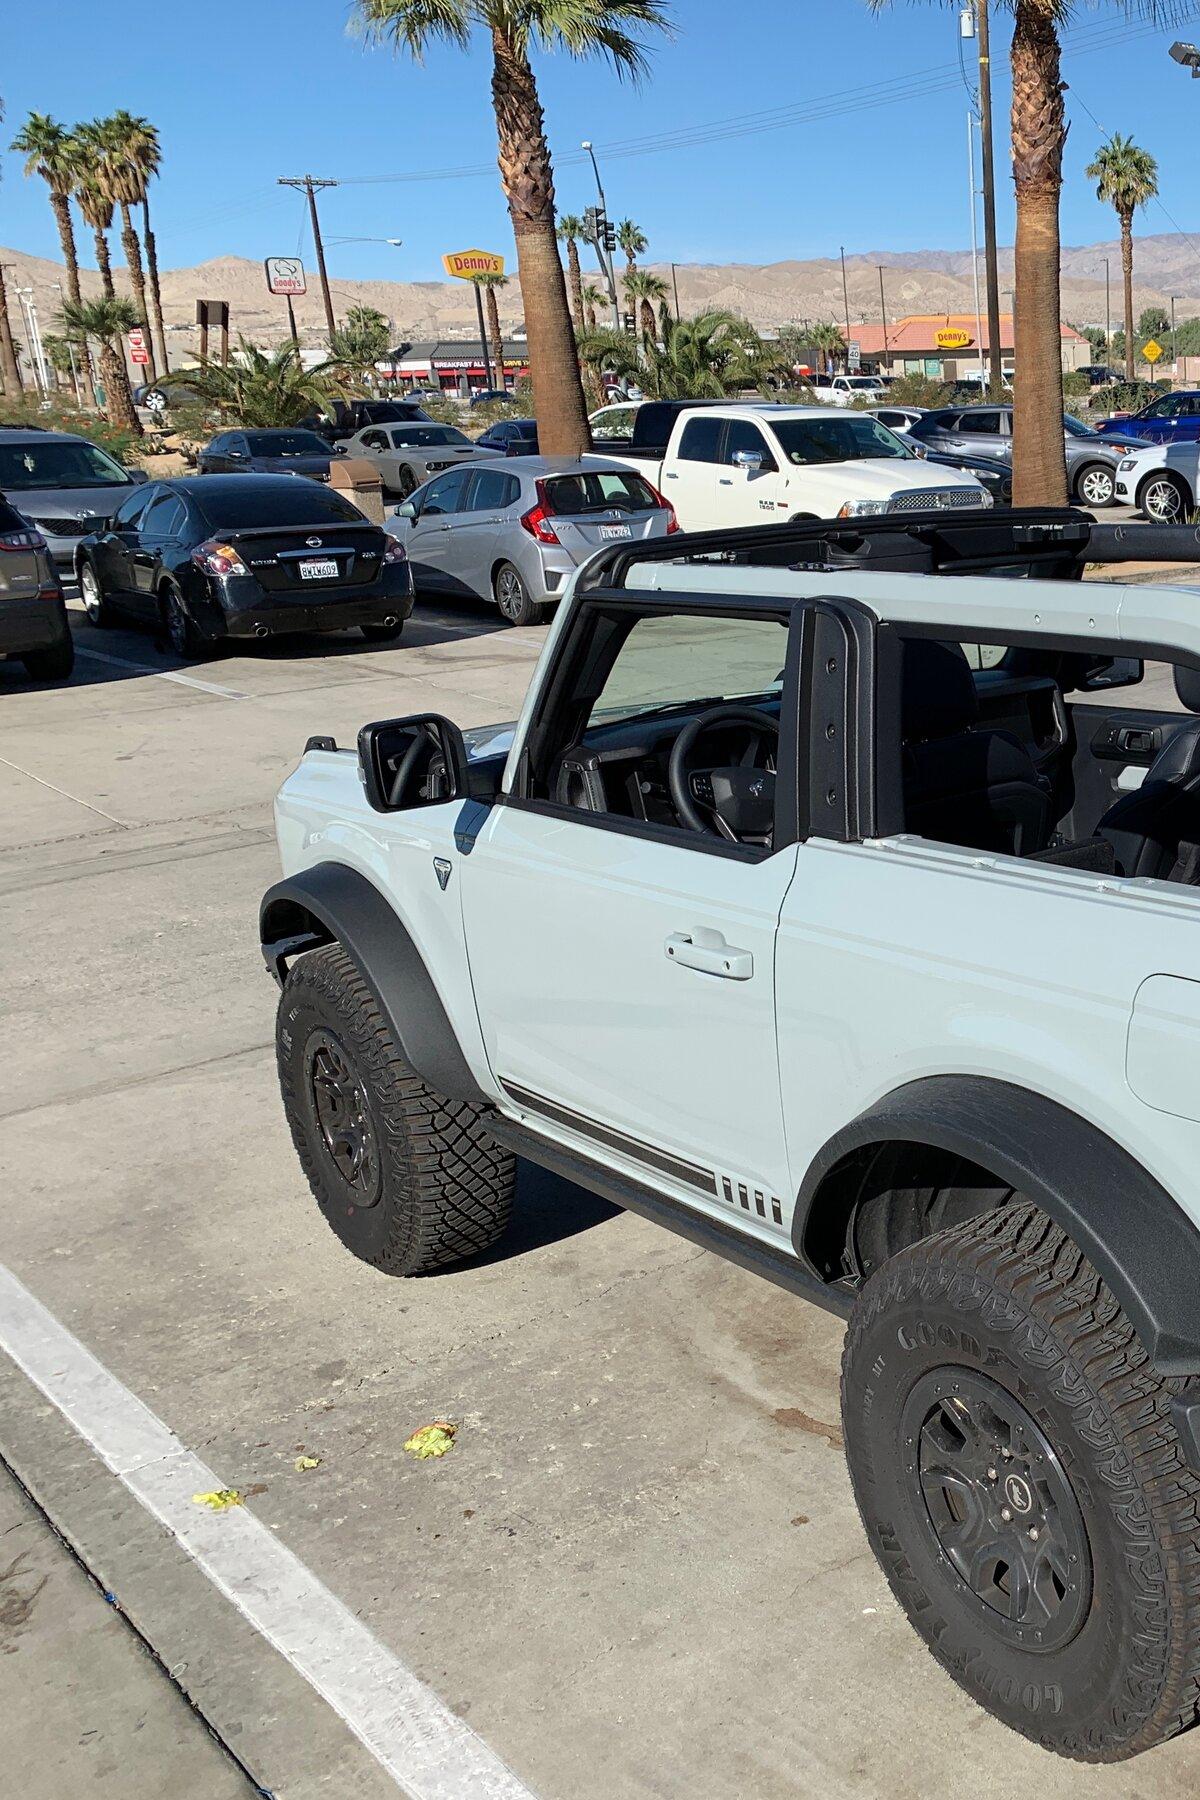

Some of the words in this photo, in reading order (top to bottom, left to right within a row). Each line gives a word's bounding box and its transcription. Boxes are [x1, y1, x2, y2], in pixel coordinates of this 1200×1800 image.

[453, 257, 499, 271] Denny's
[273, 276, 302, 288] Goody's
[937, 331, 967, 342] Denny's
[849, 350, 859, 358] 40
